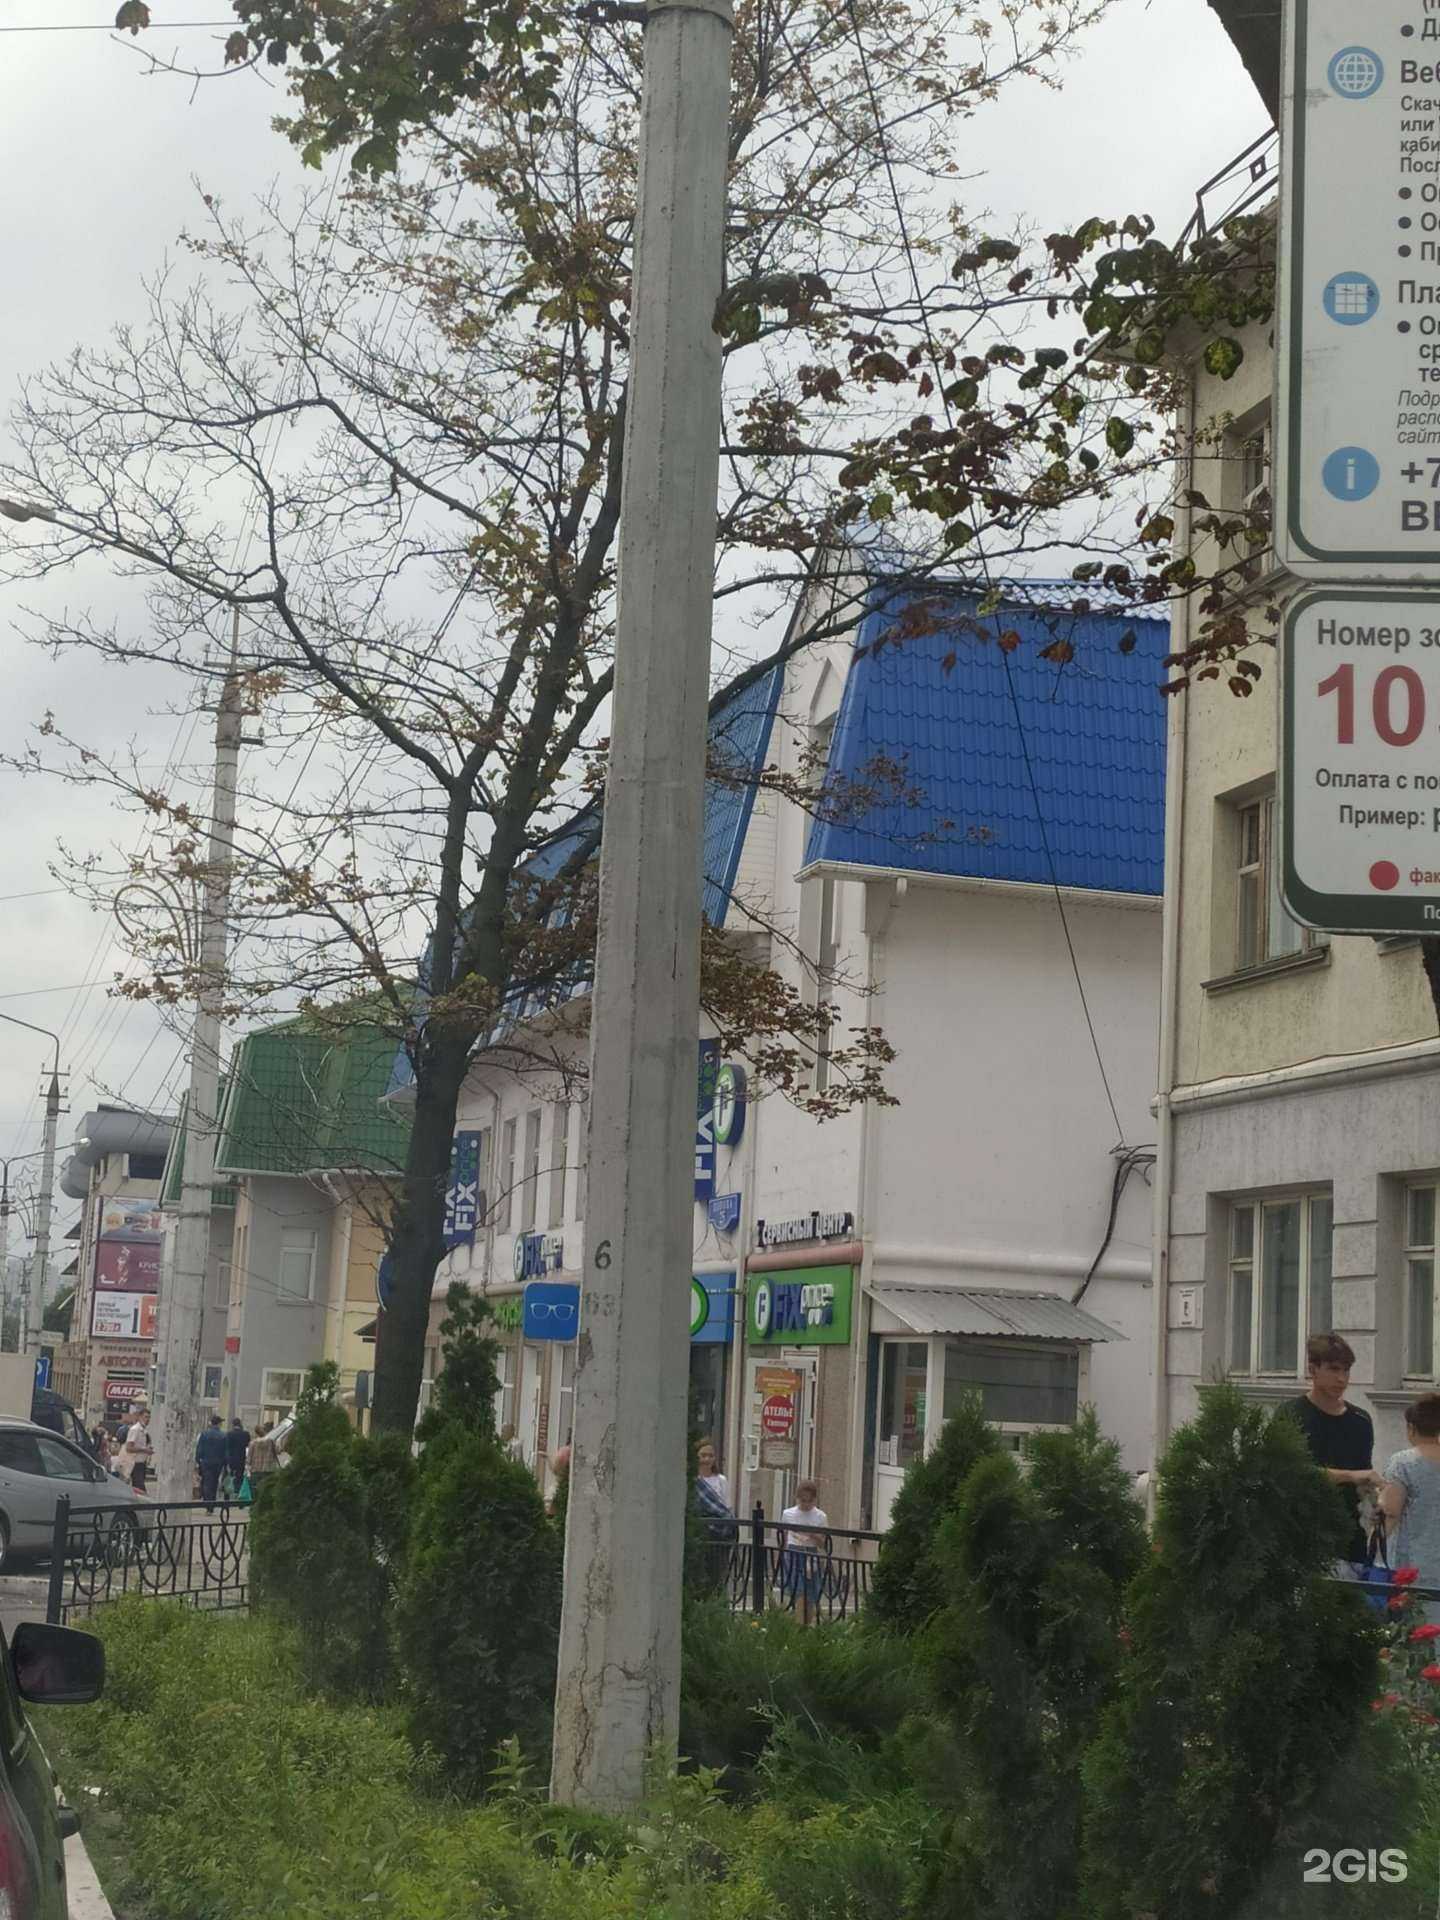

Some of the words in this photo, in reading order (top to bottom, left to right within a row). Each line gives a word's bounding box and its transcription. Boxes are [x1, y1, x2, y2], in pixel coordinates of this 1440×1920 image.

[1421, 18, 1440, 41] Д
[1400, 120, 1435, 132] или
[1418, 367, 1440, 382] те
[1398, 390, 1440, 410] Подр
[1401, 457, 1440, 488] +7
[1317, 618, 1411, 654] Номер
[1318, 663, 1440, 747] 10
[1316, 768, 1390, 789] Оплата
[1396, 774, 1408, 789] с
[1414, 775, 1440, 790] по
[1339, 804, 1426, 830] Пример:
[454, 1181, 478, 1231] FIX
[815, 1211, 851, 1239] ЦЕНТР
[594, 1239, 612, 1270] 6
[773, 1283, 806, 1330] FIX
